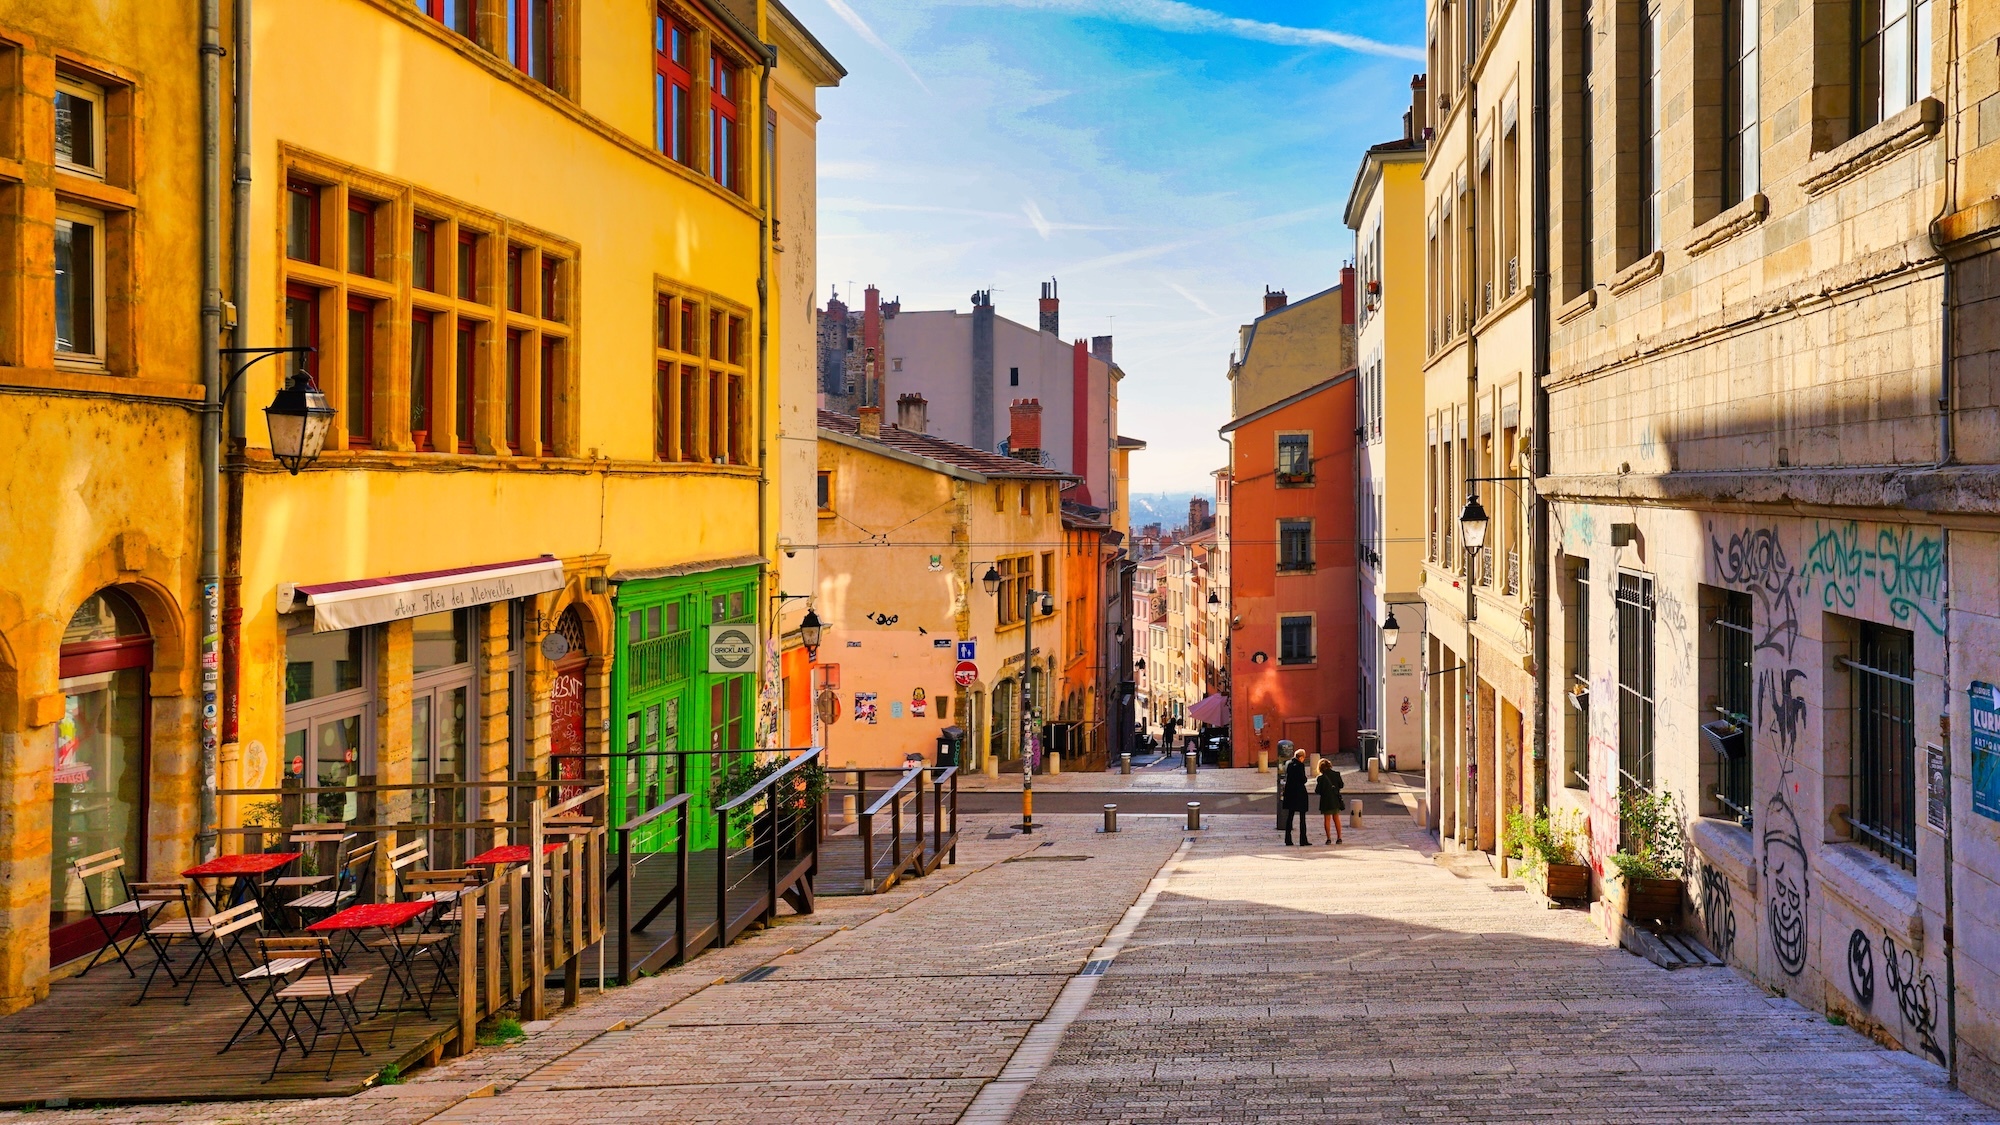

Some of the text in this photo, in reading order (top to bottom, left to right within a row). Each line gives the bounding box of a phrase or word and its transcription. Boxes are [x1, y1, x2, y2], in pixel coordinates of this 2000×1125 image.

[395, 580, 514, 616] Aux Thés des Merveilles
[1973, 686, 1991, 696] MUSIQUE
